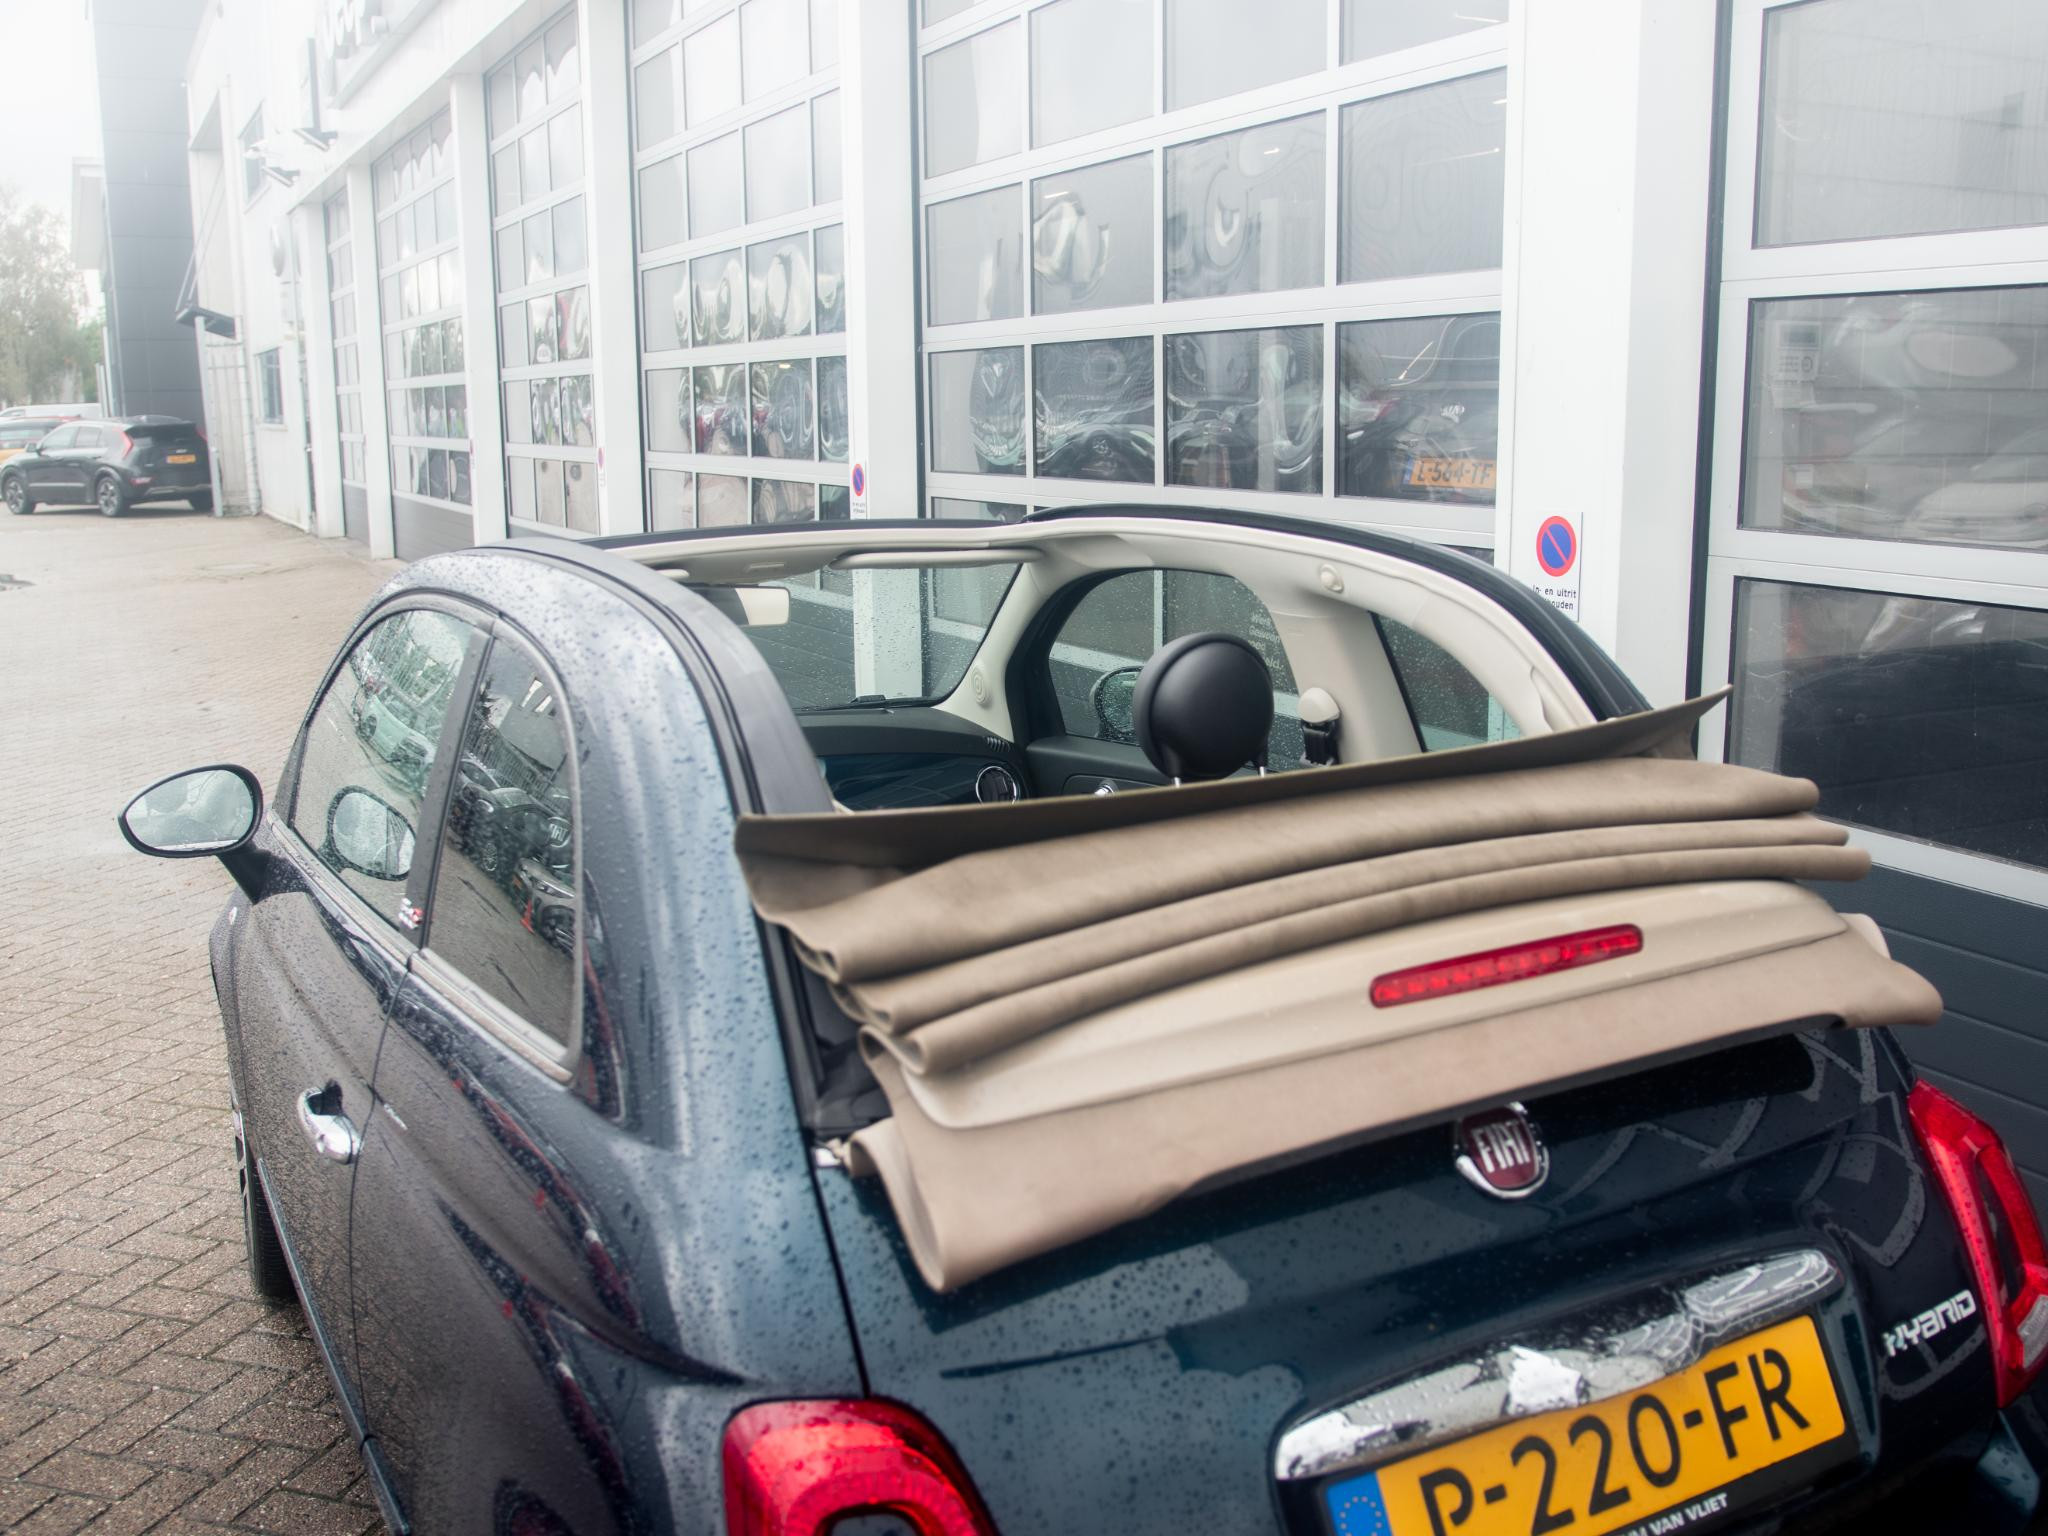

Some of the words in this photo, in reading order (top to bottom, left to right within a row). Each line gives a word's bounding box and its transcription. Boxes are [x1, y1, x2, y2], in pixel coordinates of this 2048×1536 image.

[1557, 588, 1577, 598] uitrit
[1471, 1120, 1531, 1173] FIAT
[1882, 1289, 1977, 1357] HYBRID
[1418, 1347, 1811, 1536] P-220-FR
[1648, 1511, 1685, 1536] VAN
[1684, 1492, 1727, 1521] VLIET
